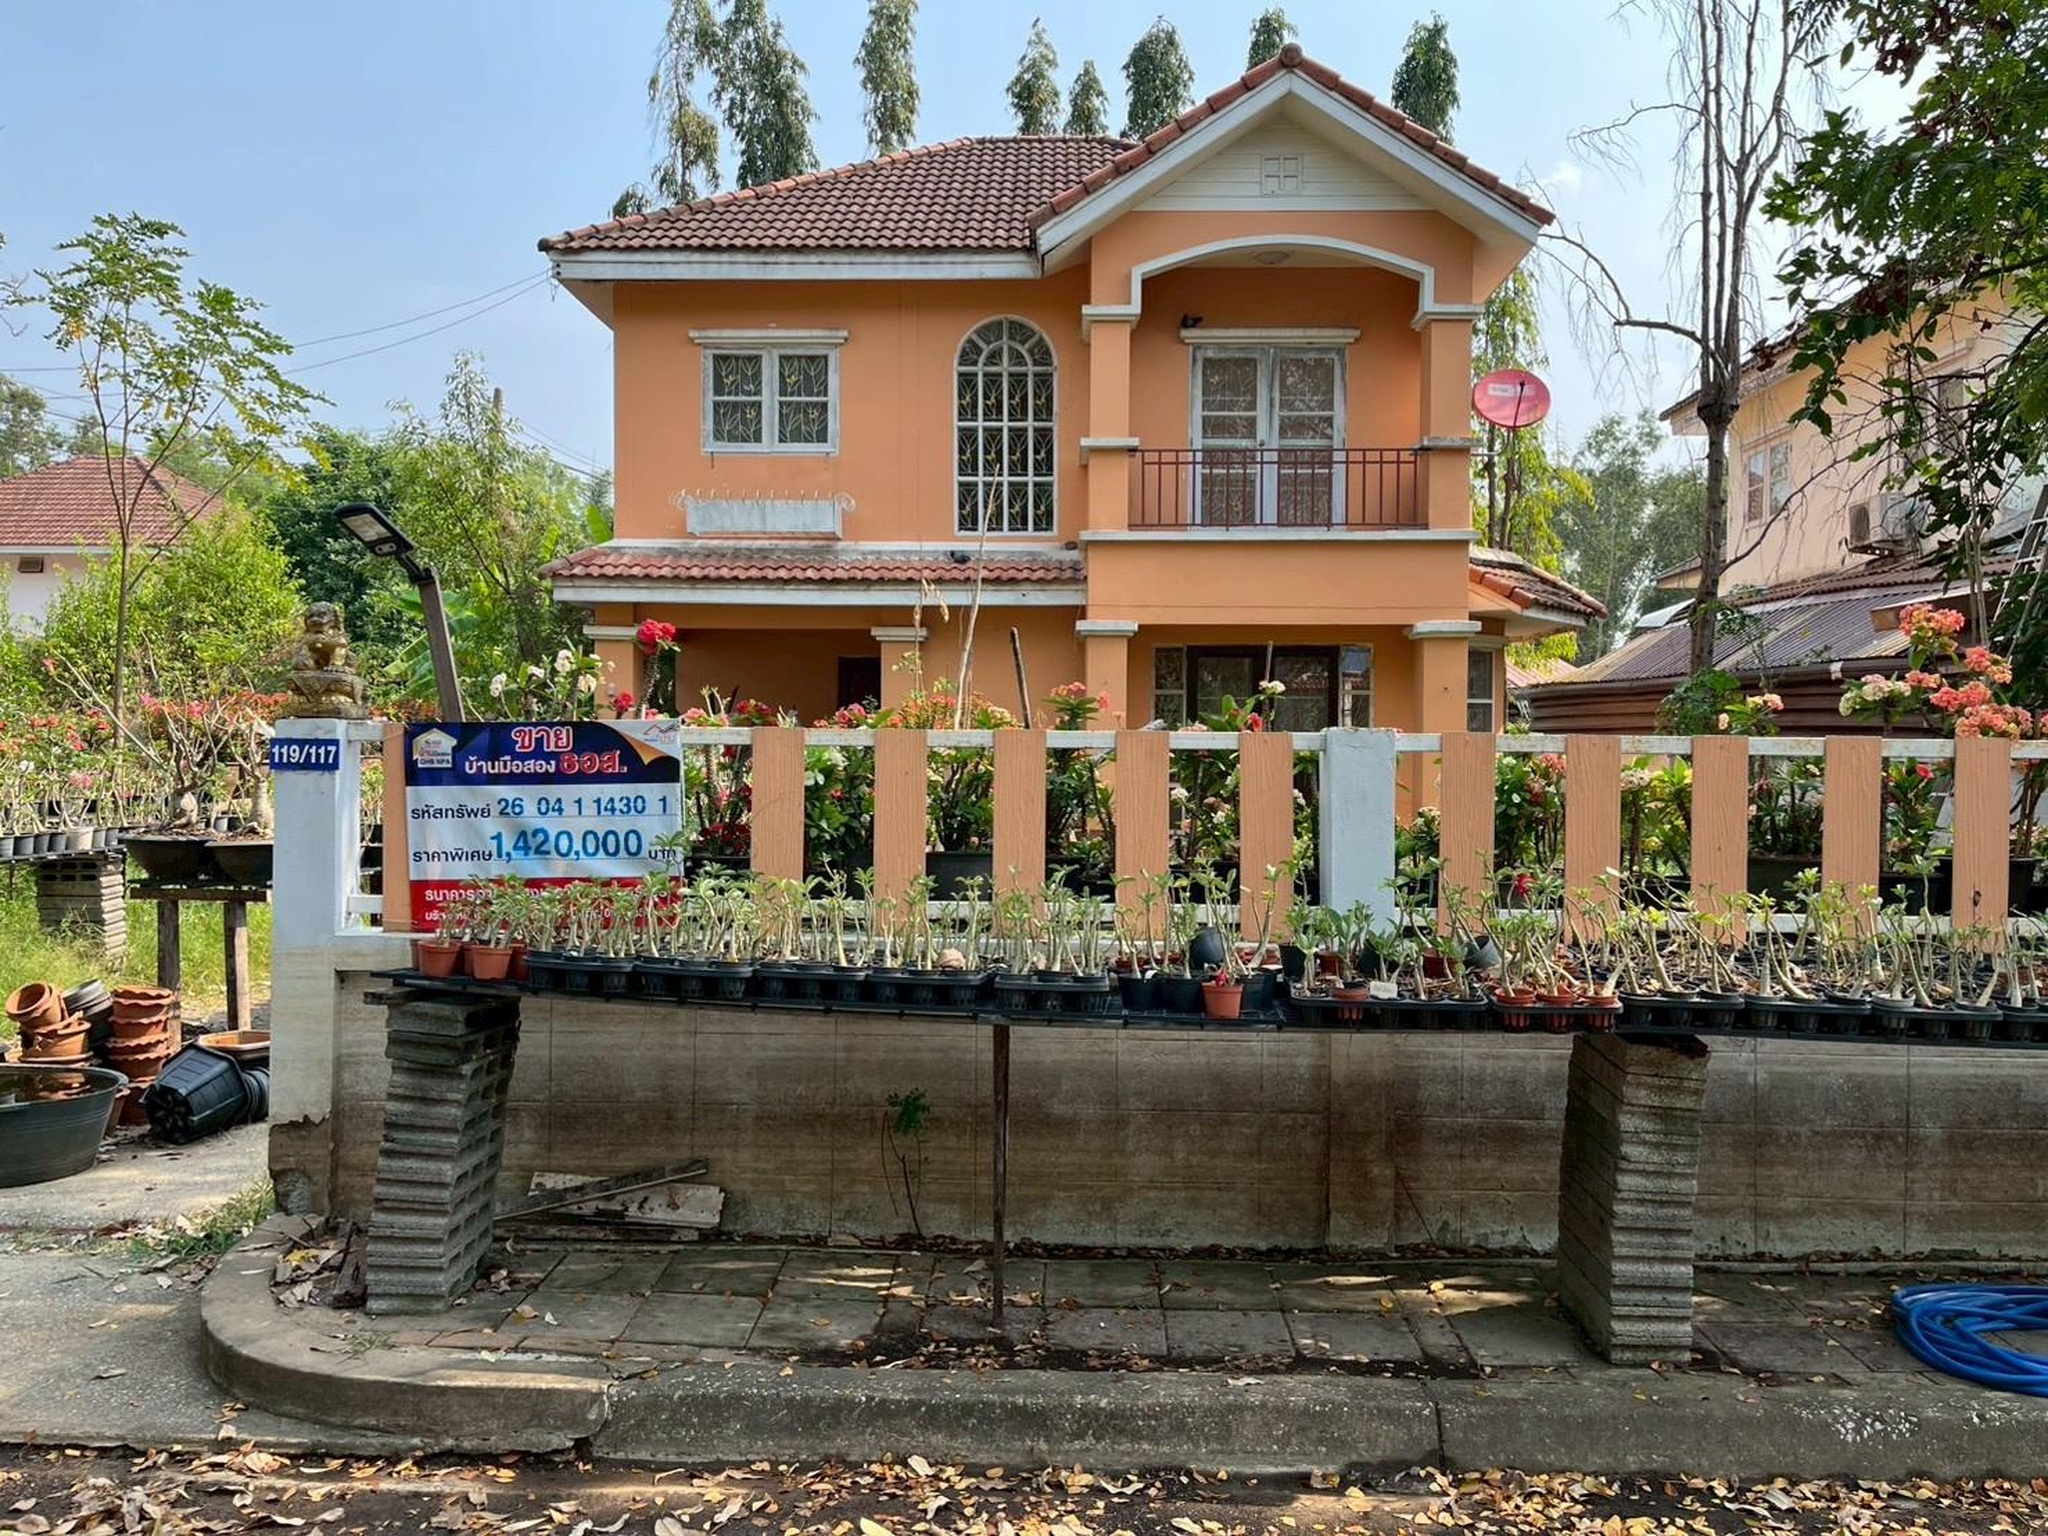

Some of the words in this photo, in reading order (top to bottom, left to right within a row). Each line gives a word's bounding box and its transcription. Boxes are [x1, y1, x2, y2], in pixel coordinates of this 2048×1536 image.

[511, 726, 574, 751] ขาย
[271, 745, 337, 763] 119/117
[464, 755, 556, 774] บ้านมือสอง
[411, 803, 491, 819] รหัสทรัพย์
[497, 797, 524, 816] 26
[537, 796, 564, 815] 04
[658, 795, 667, 814] 1
[412, 847, 493, 862] ราคาพิเศษ
[490, 826, 643, 863] 1,420,000
